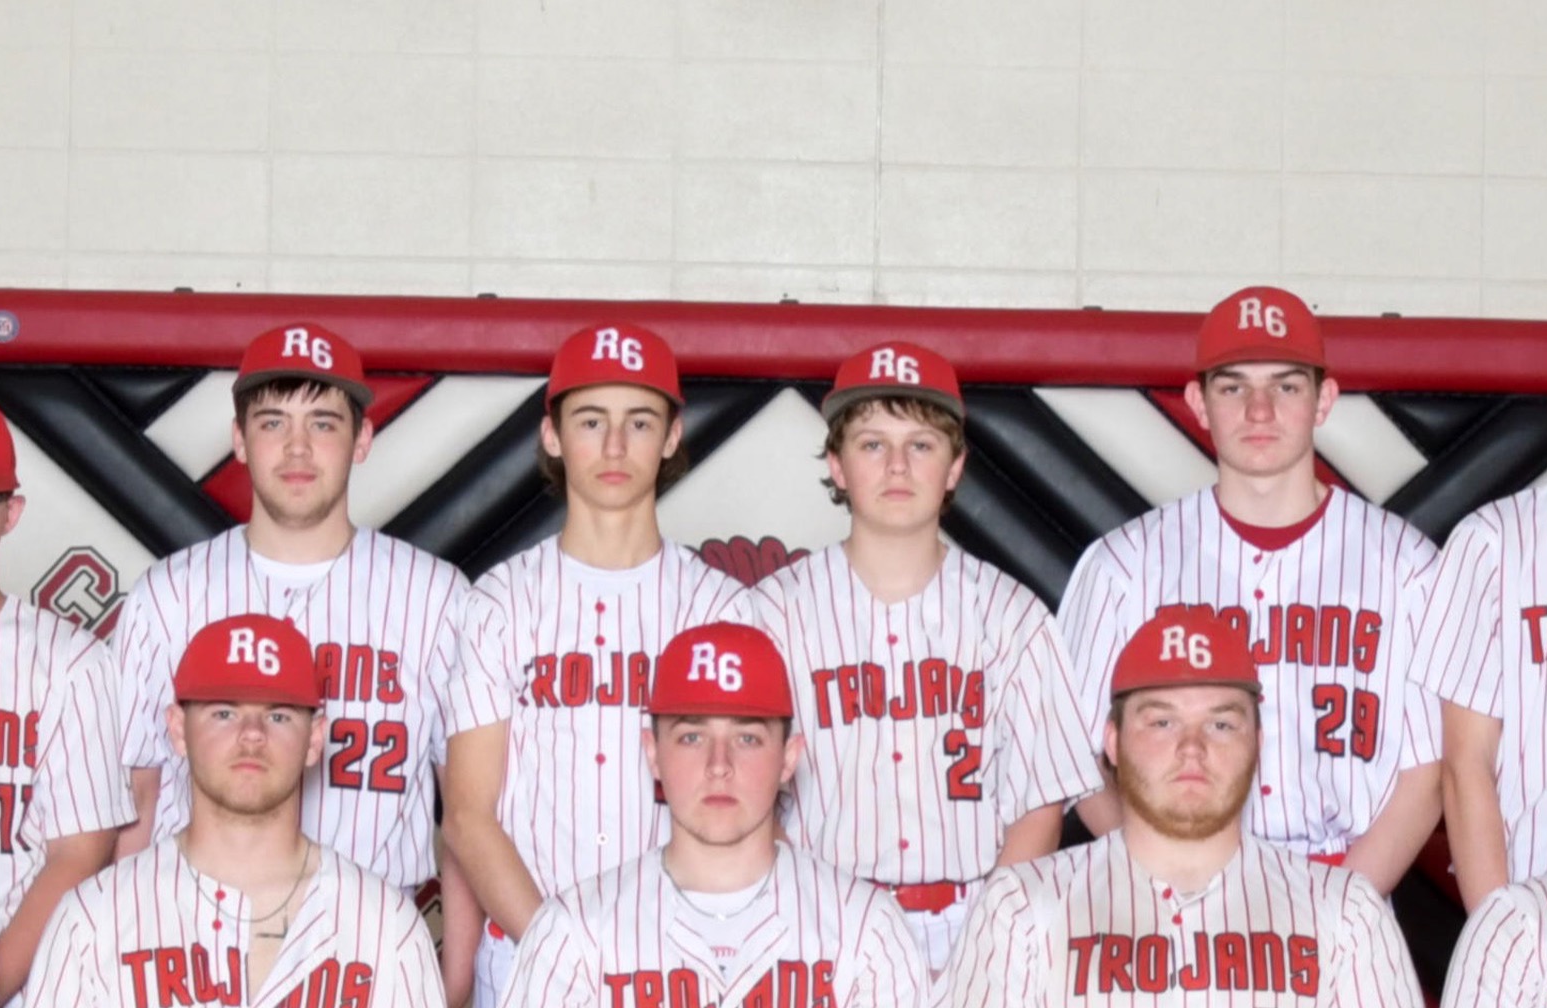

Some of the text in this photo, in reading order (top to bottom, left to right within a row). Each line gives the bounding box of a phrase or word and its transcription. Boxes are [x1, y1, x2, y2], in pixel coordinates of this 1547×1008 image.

[1239, 297, 1287, 338] R6
[281, 327, 334, 370] R6
[591, 327, 645, 372] R6
[869, 347, 921, 386] R6
[226, 626, 282, 677] R6
[686, 640, 744, 693] R6
[1158, 624, 1213, 670] R6
[1312, 684, 1380, 762] 29
[329, 718, 409, 793] 22
[943, 728, 983, 802] 2
[1068, 931, 1321, 998] TROJANS
